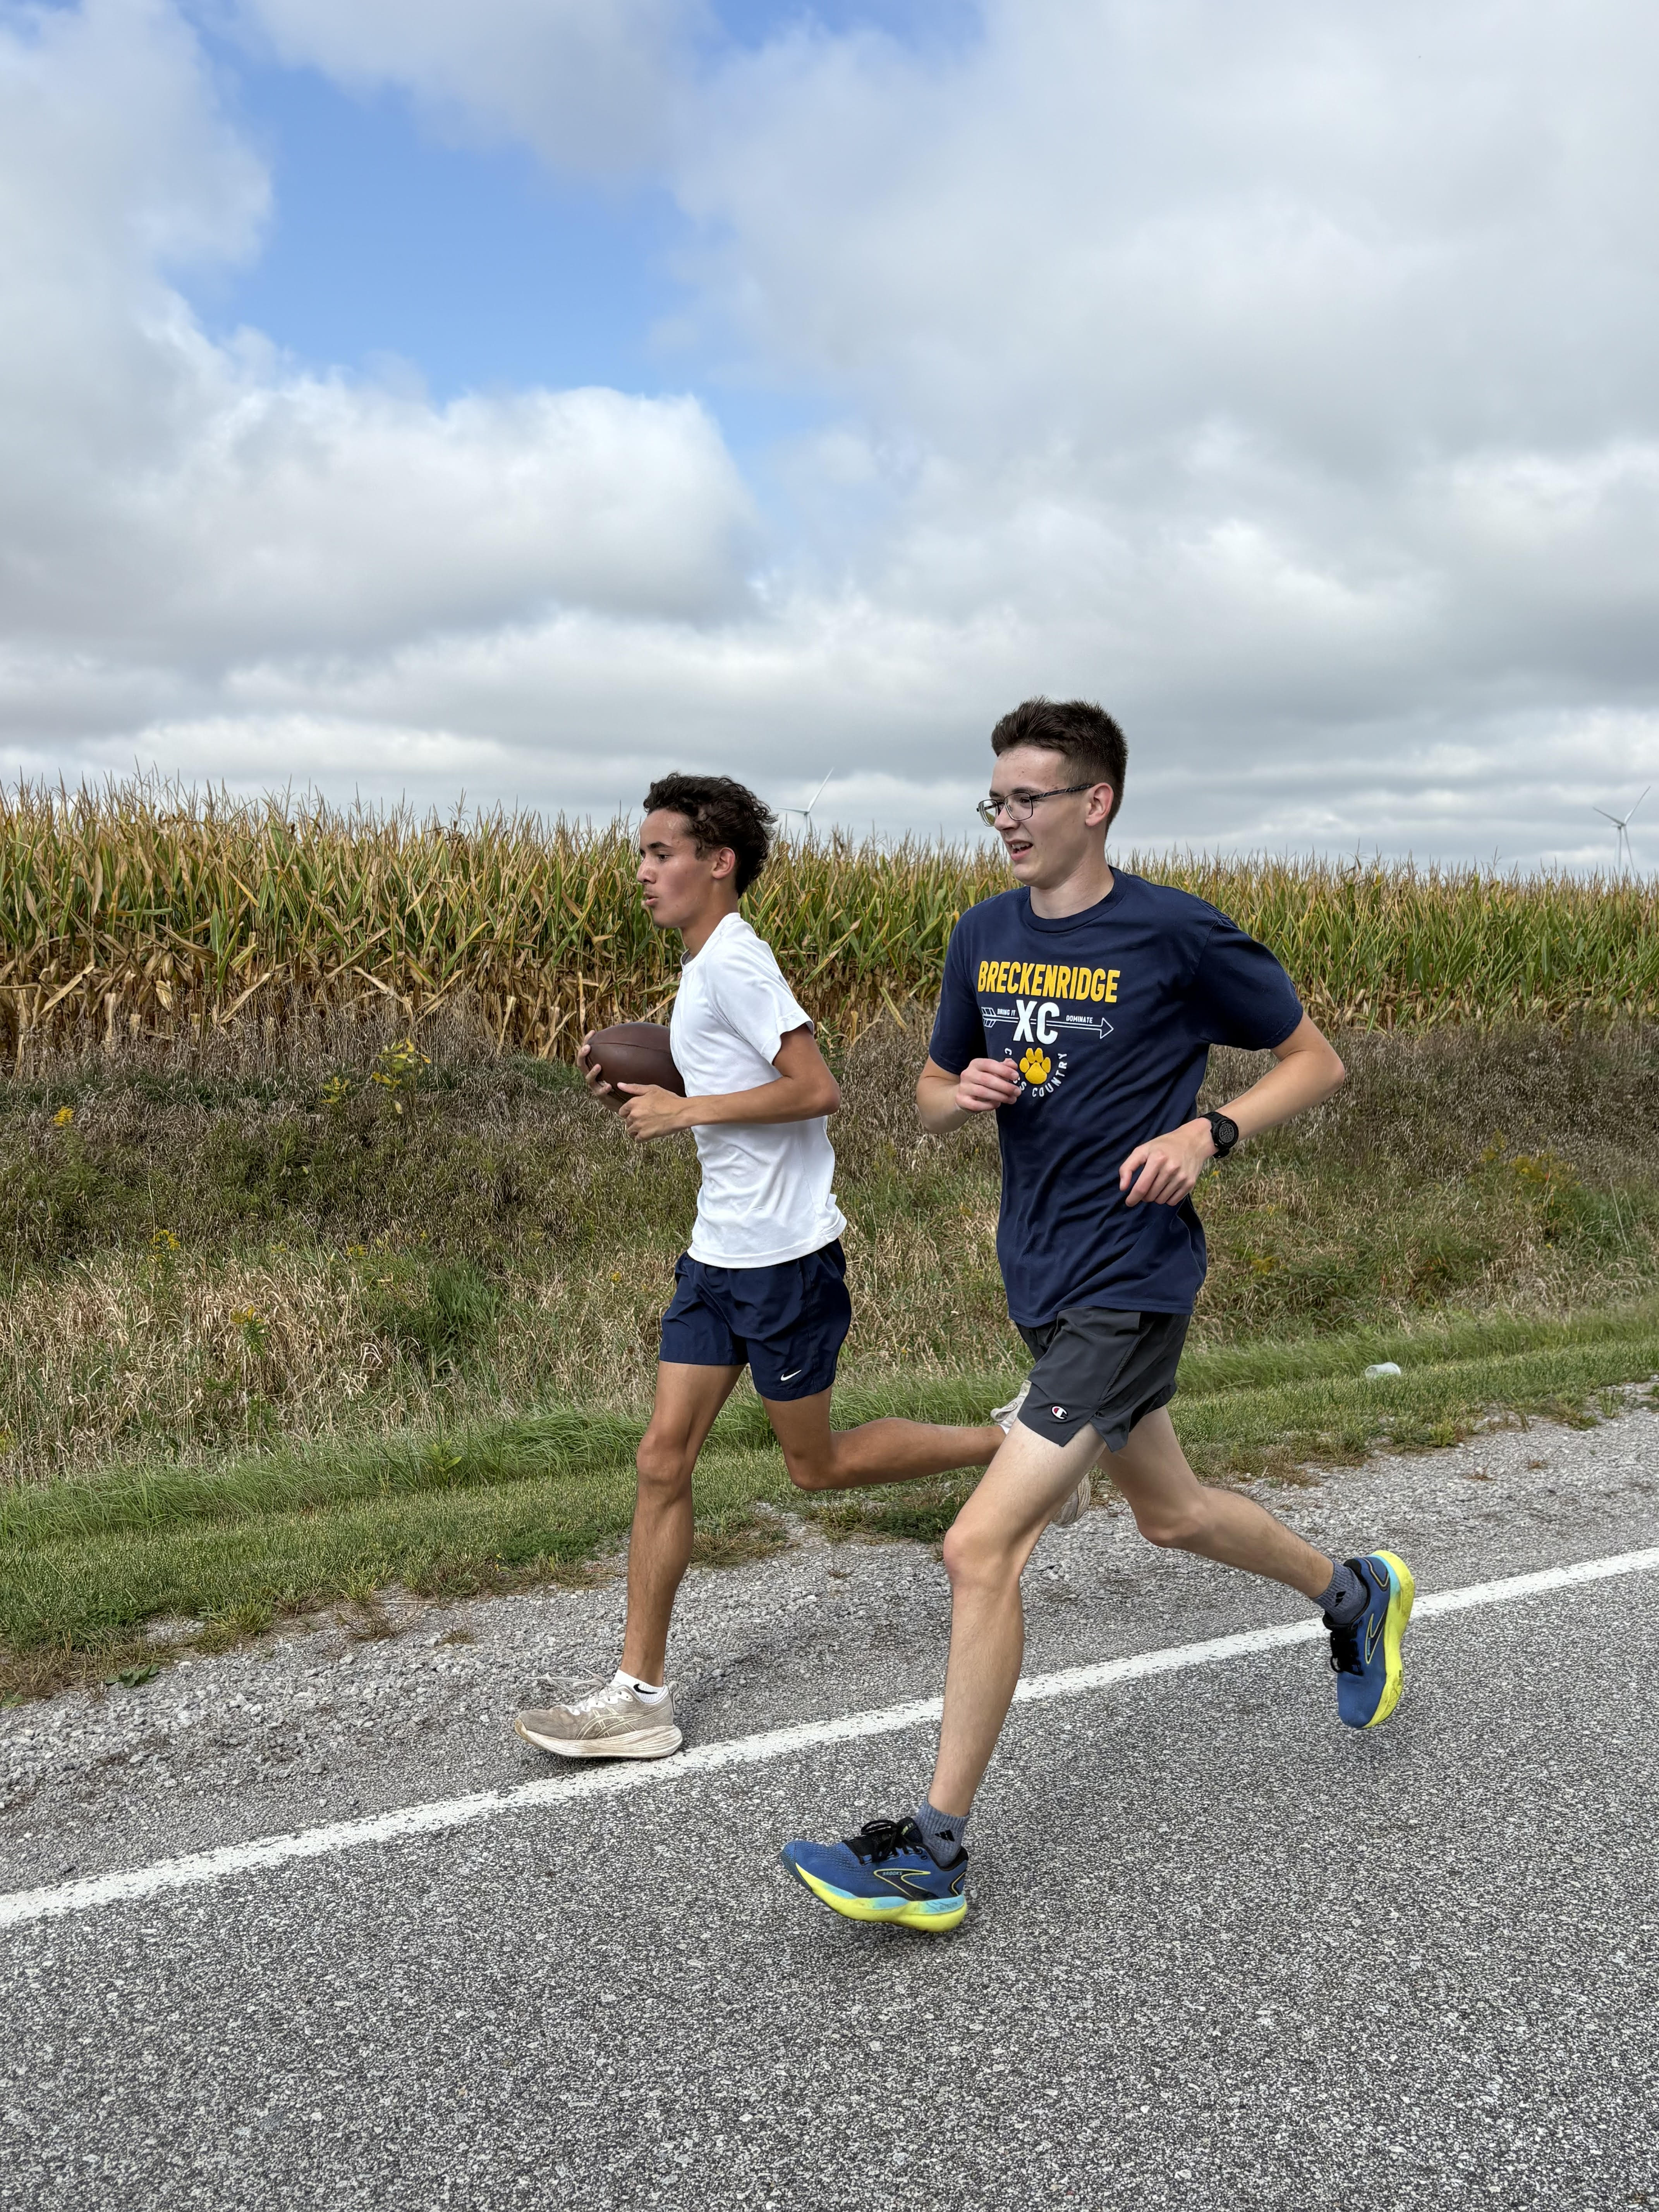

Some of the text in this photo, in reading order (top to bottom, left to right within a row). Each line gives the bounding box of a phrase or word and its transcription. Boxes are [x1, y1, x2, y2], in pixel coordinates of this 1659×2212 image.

[978, 961, 1120, 1003] BRECKENRIDGE
[1013, 1000, 1060, 1044] XC
[1066, 1015, 1093, 1024] DOMINATE
[1032, 1053, 1067, 1097] COUNTRY
